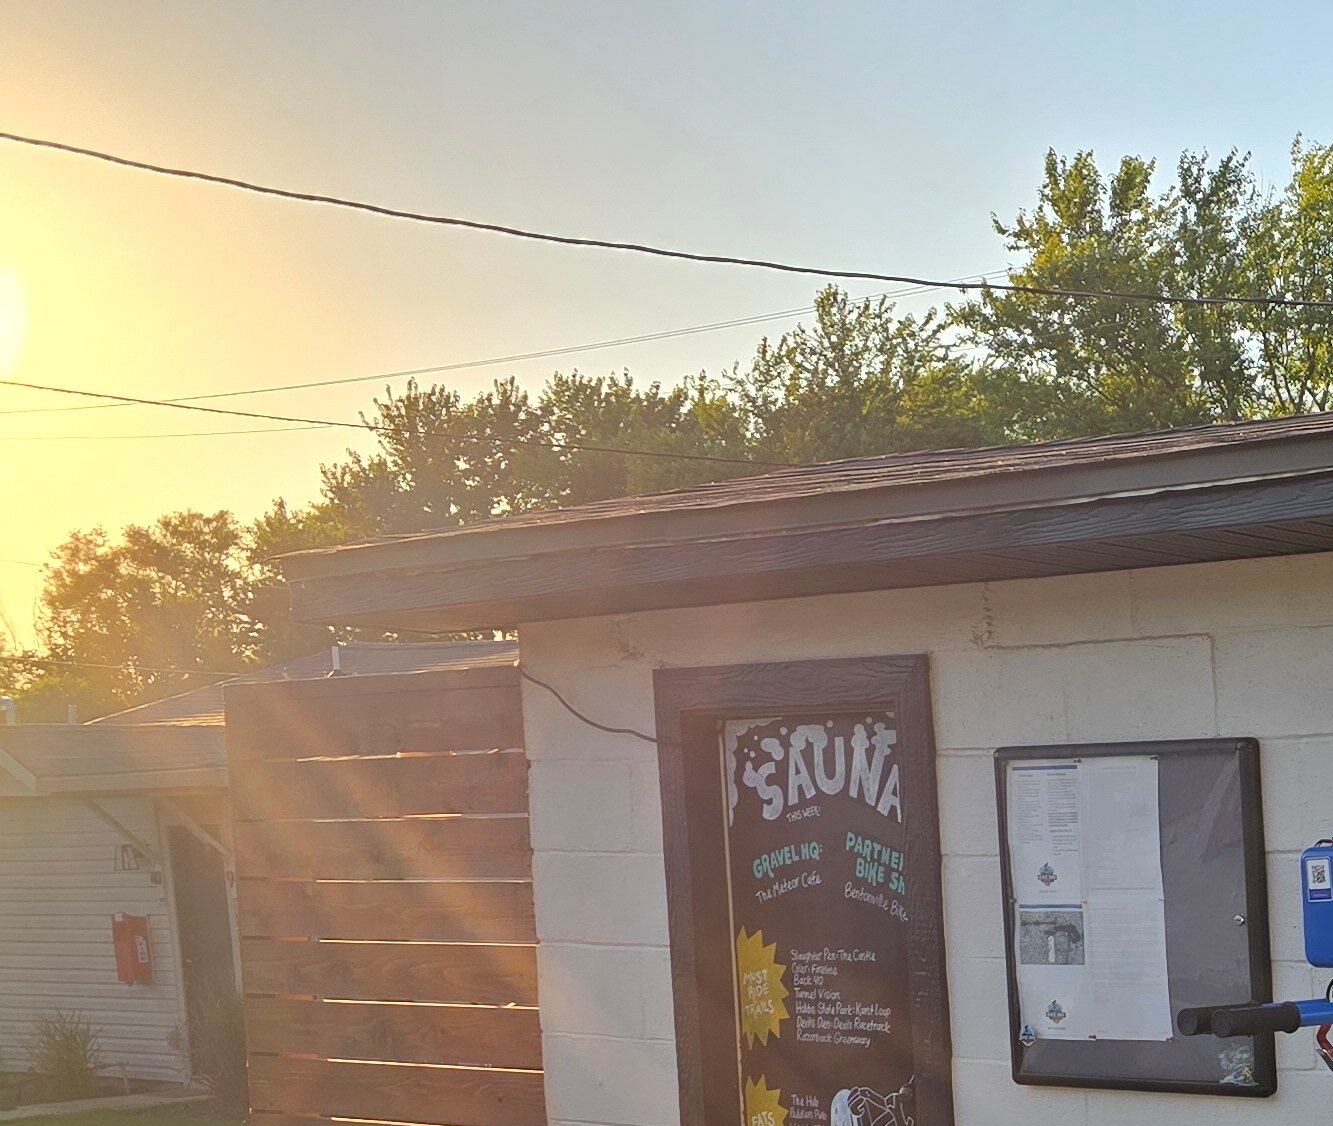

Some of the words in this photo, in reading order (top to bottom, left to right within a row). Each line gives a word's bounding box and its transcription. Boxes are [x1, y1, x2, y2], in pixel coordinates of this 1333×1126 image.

[755, 730, 902, 824] SAUNA
[752, 845, 800, 879] GRAVEL
[800, 841, 823, 861] HQ:
[856, 858, 885, 887] BIKE
[755, 887, 773, 904] The
[773, 875, 800, 898] Meteor
[743, 969, 768, 985] MUST
[793, 975, 813, 986] Back
[747, 983, 769, 999] RIDE
[793, 987, 816, 1000] Tunnel
[817, 988, 841, 1000] Vision
[745, 1000, 775, 1020] TRAILS
[875, 1003, 892, 1018] Loop
[854, 1017, 891, 1034] Racetrack
[834, 1032, 871, 1048] Greenway
[789, 1093, 804, 1107] The
